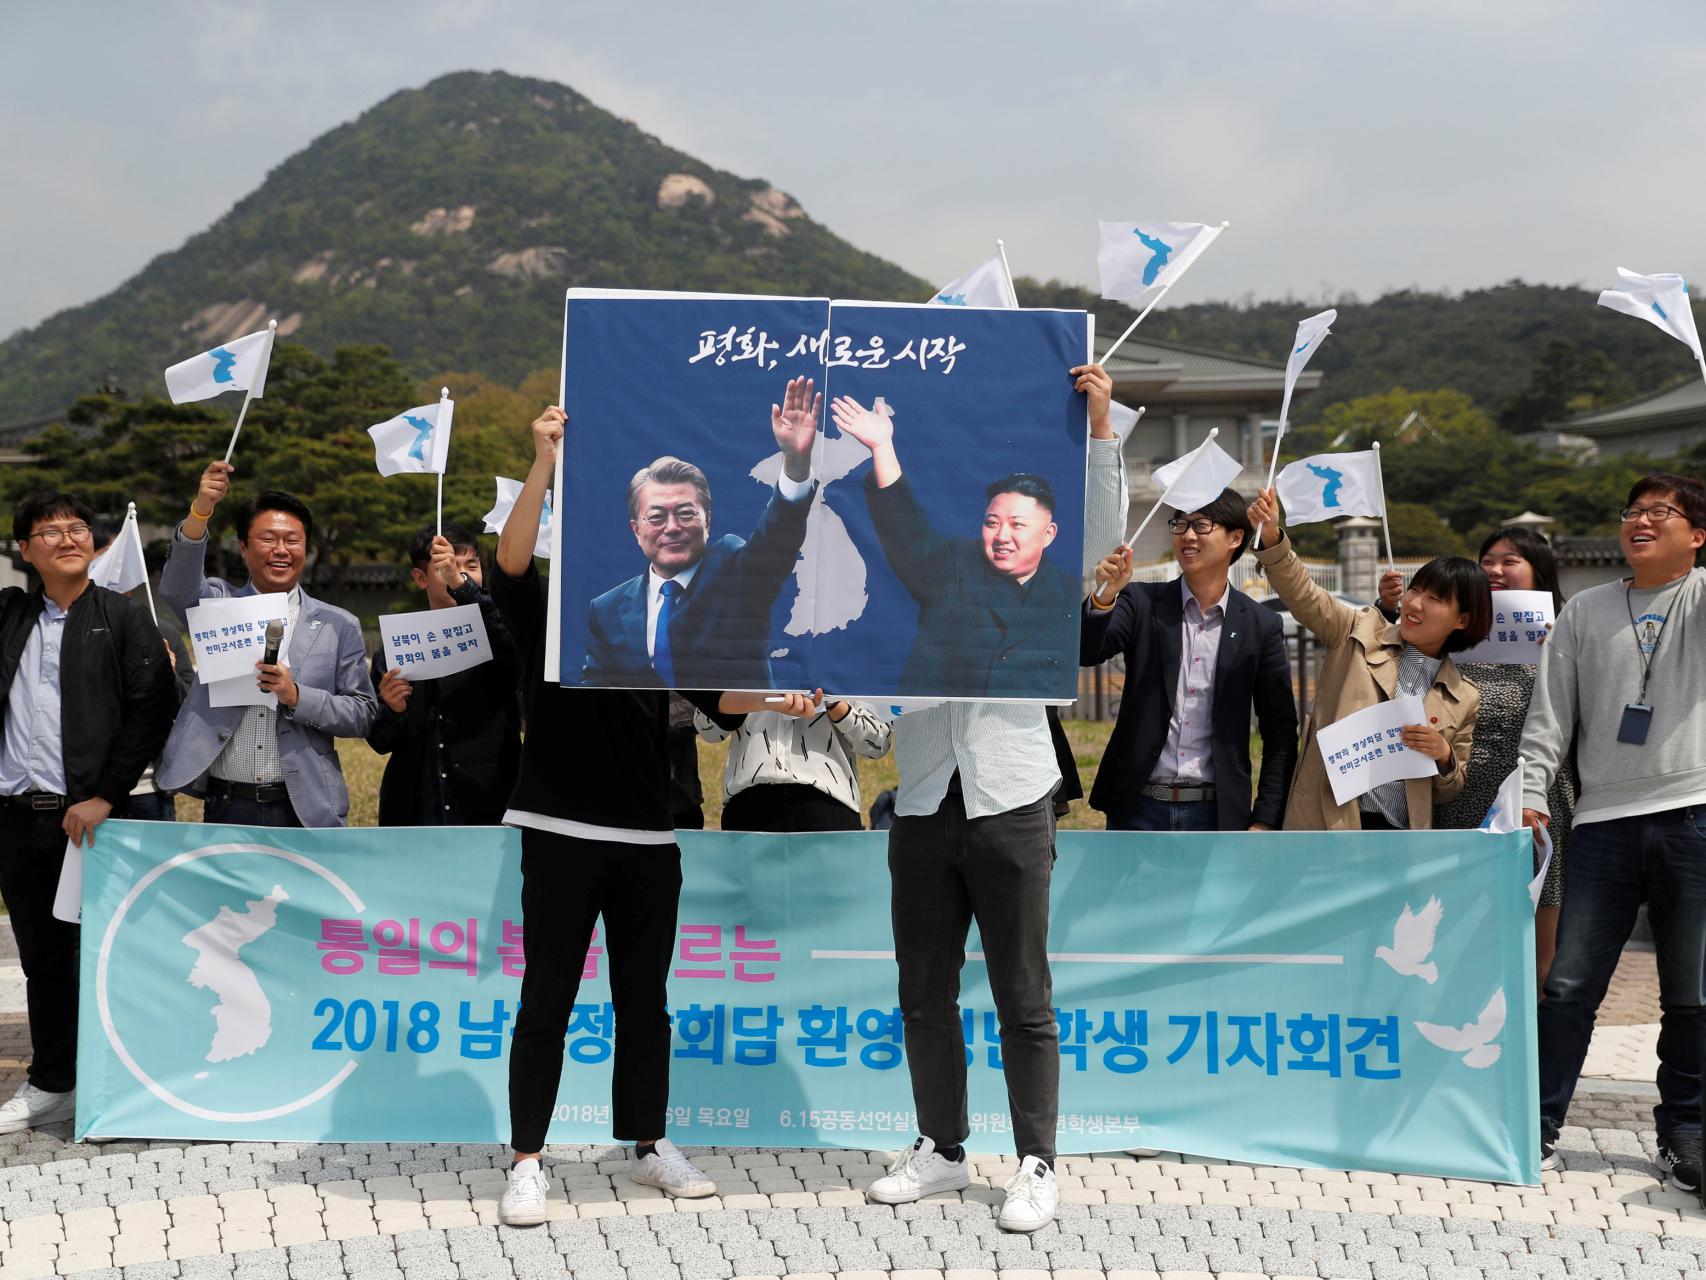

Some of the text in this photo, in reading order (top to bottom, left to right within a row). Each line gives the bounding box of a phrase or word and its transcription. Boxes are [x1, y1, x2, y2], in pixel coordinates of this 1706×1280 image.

[689, 326, 967, 374] 평화, 새로운 시작
[1496, 611, 1544, 624] 손 맞잡고
[194, 629, 217, 642] 평화의
[221, 622, 253, 636] 정상회담
[392, 623, 474, 647] 남북이 손 맞잡고
[1498, 630, 1518, 642] 봄을
[205, 637, 252, 655] 한미군사훈련
[395, 638, 478, 666] 평화의 봄을 열자
[1328, 747, 1349, 764] 평화의
[1352, 732, 1383, 752] 정상회담
[1339, 748, 1384, 774] 한미군사훈련
[316, 918, 478, 976] 통일의
[674, 924, 781, 982] 르는
[312, 998, 440, 1054] 2018
[459, 1000, 784, 1066] 남정회담
[796, 1004, 905, 1070] 환영
[1166, 1011, 1401, 1080] 기자회견
[697, 1107, 750, 1128] 목요일
